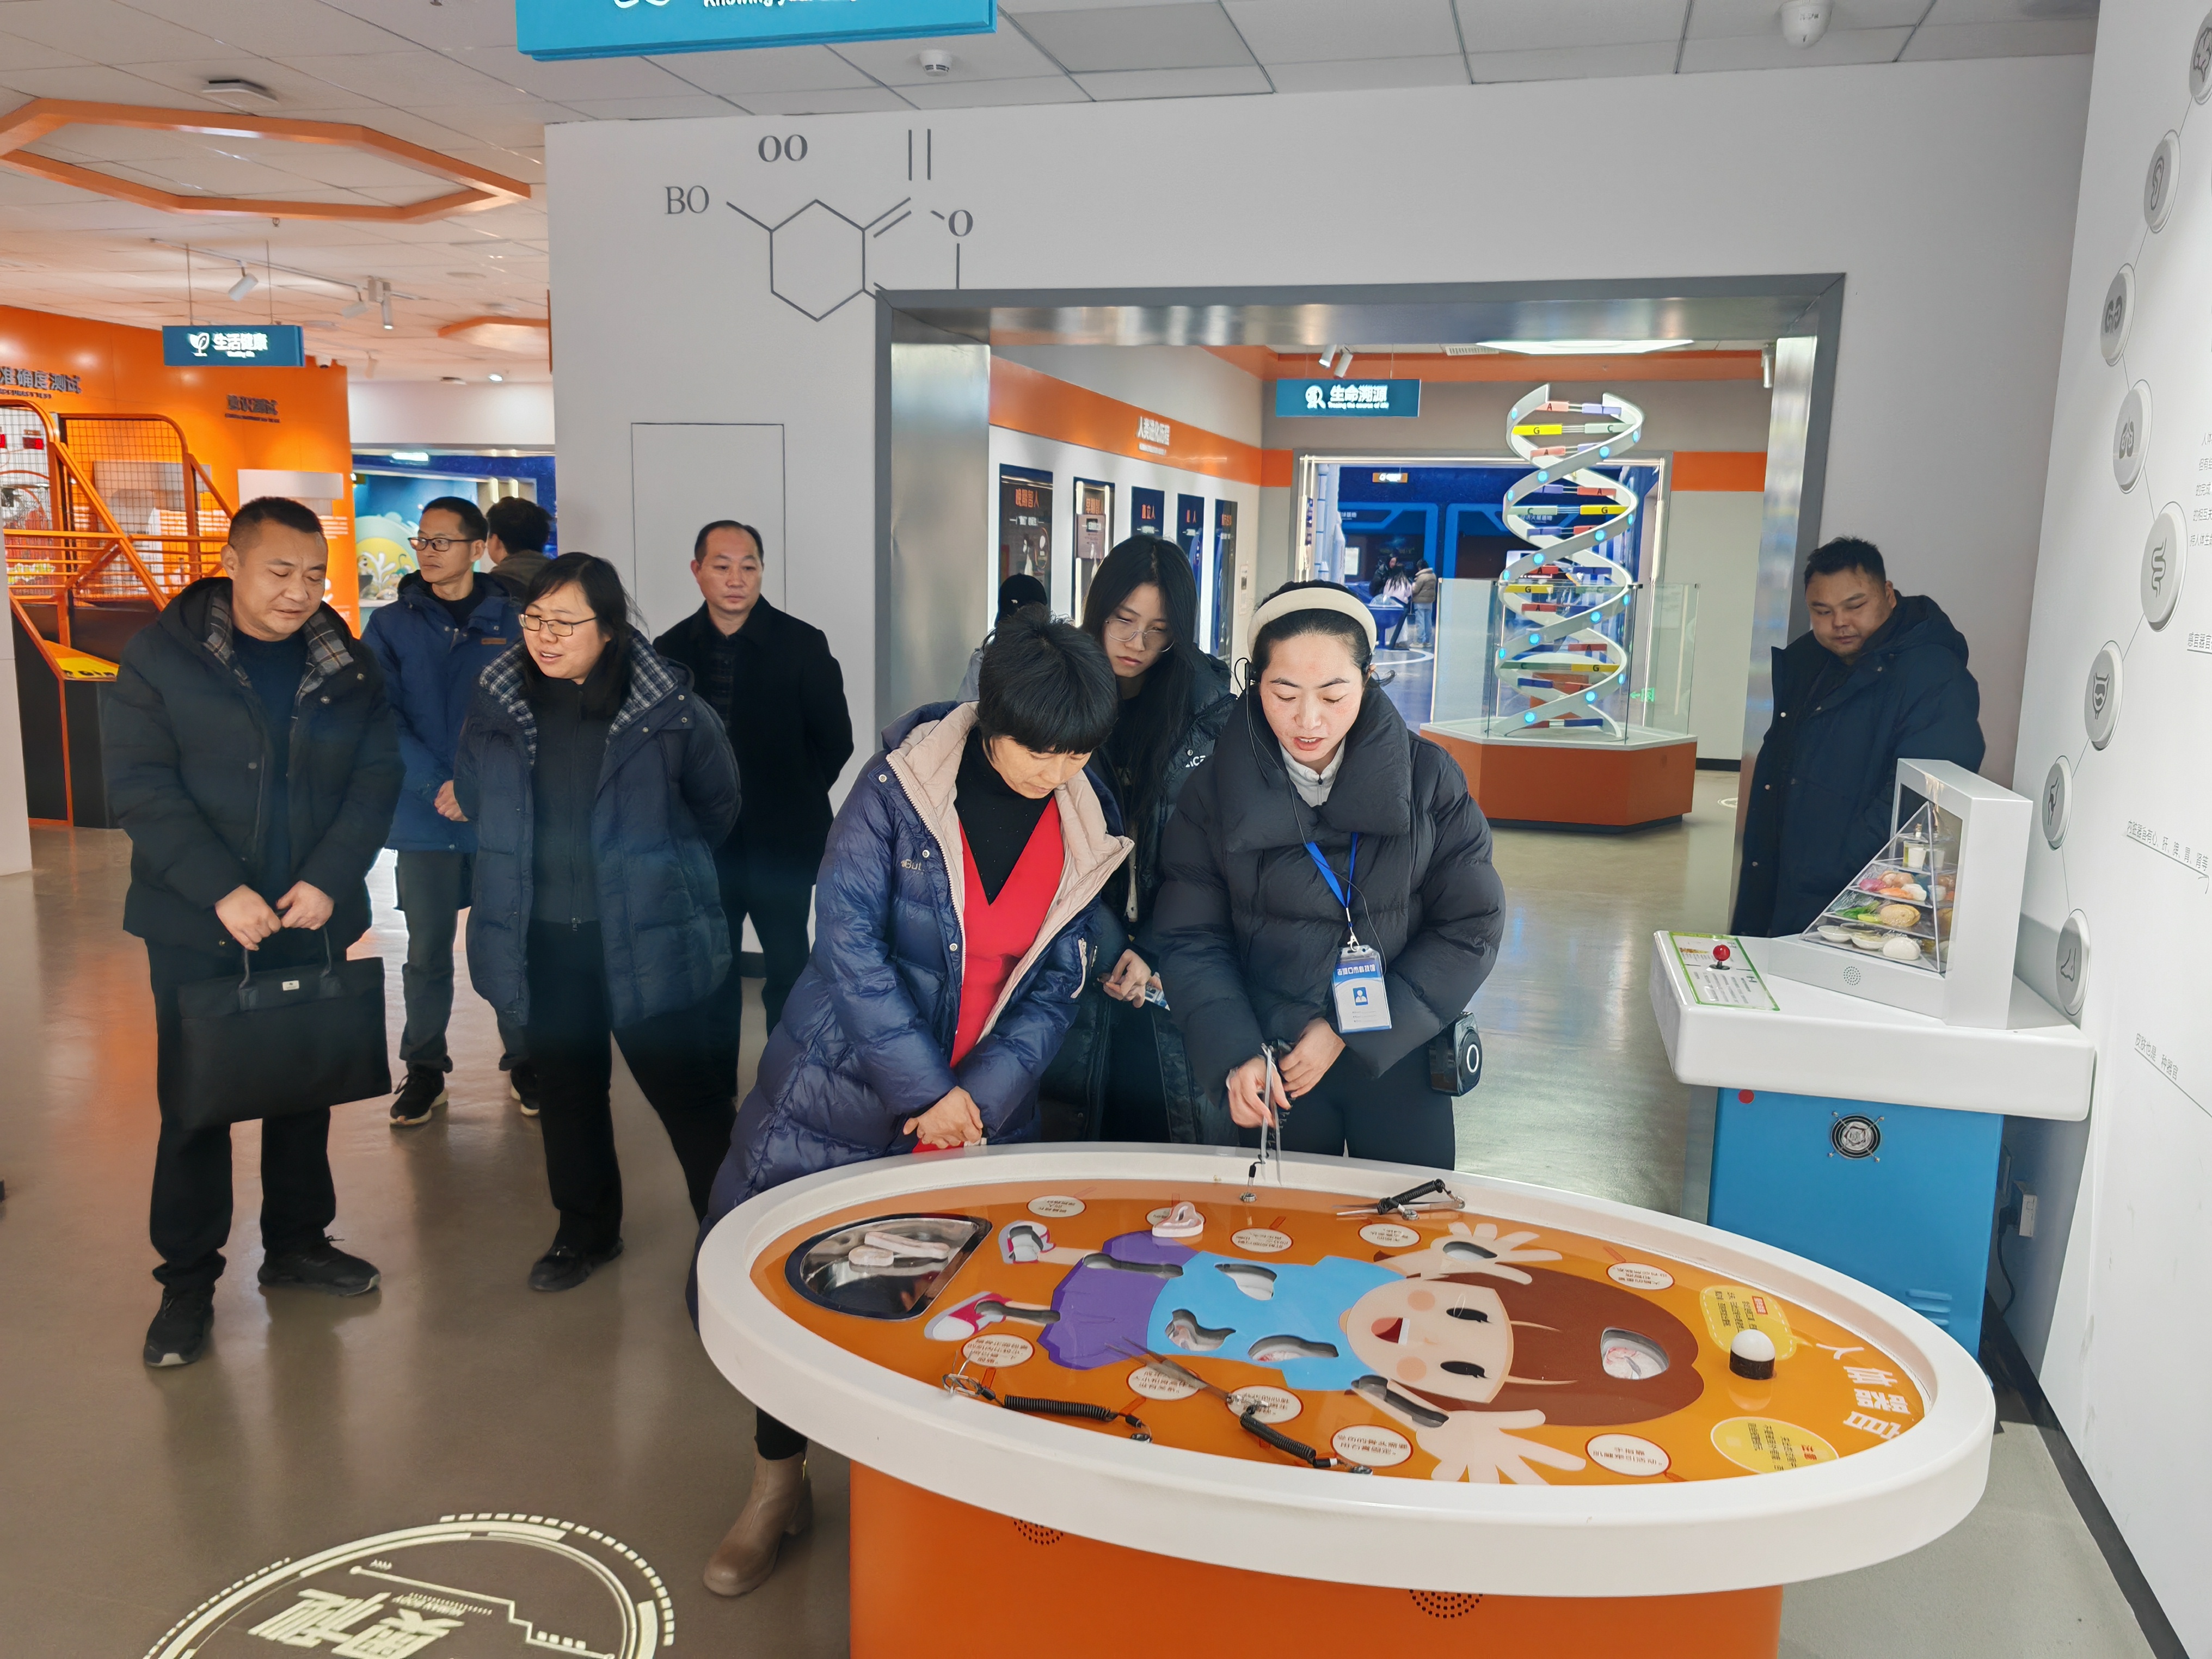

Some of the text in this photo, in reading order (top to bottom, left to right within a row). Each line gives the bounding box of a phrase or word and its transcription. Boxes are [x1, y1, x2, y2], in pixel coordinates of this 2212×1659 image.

[758, 134, 808, 163] OO
[665, 185, 710, 214] BO
[947, 209, 974, 237] O
[213, 332, 269, 351] 生活健康
[1330, 384, 1388, 403] 生命溯源
[1533, 427, 1540, 435] G
[1601, 506, 1608, 514] G
[2135, 1033, 2179, 1082] 皮肤也是种器官
